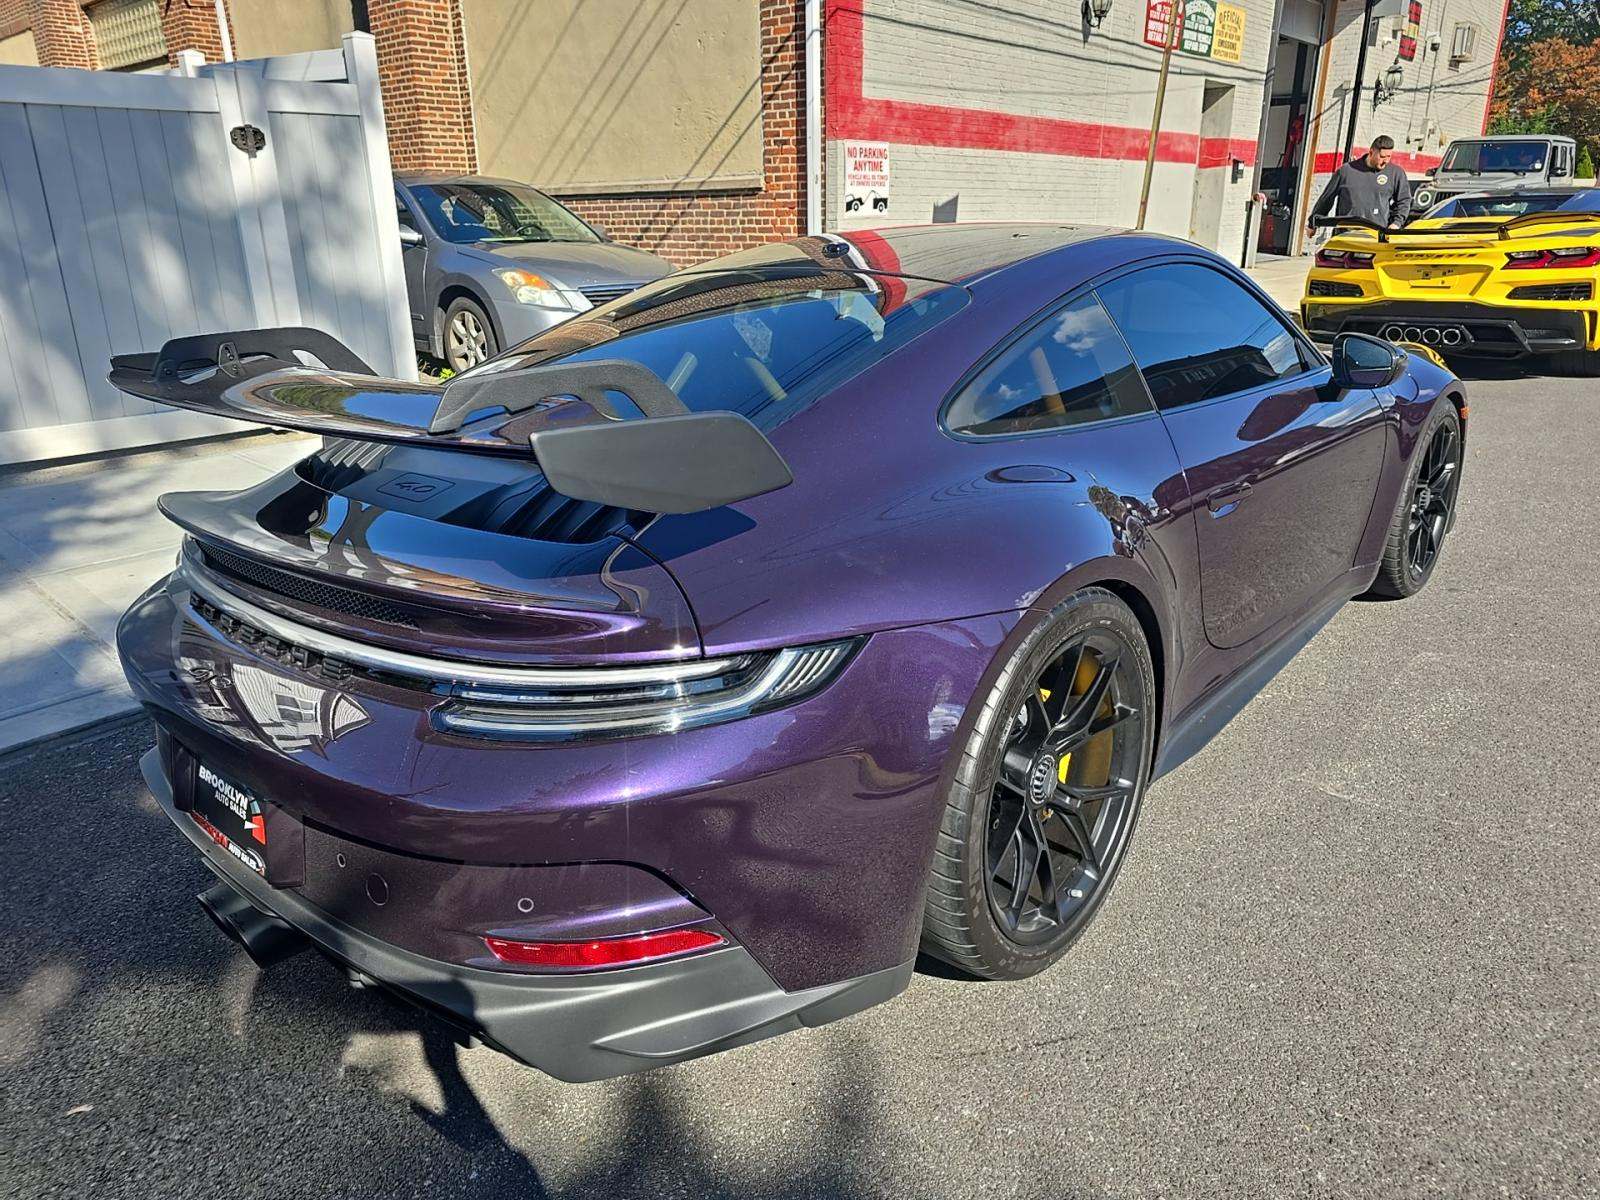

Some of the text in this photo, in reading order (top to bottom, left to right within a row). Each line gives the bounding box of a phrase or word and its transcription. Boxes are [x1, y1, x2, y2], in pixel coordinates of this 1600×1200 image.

[847, 147, 888, 160] NO PARKING
[853, 160, 883, 172] ANYTIME
[199, 765, 249, 811] BROOKLYN
[214, 790, 247, 820] AUTO SALES
